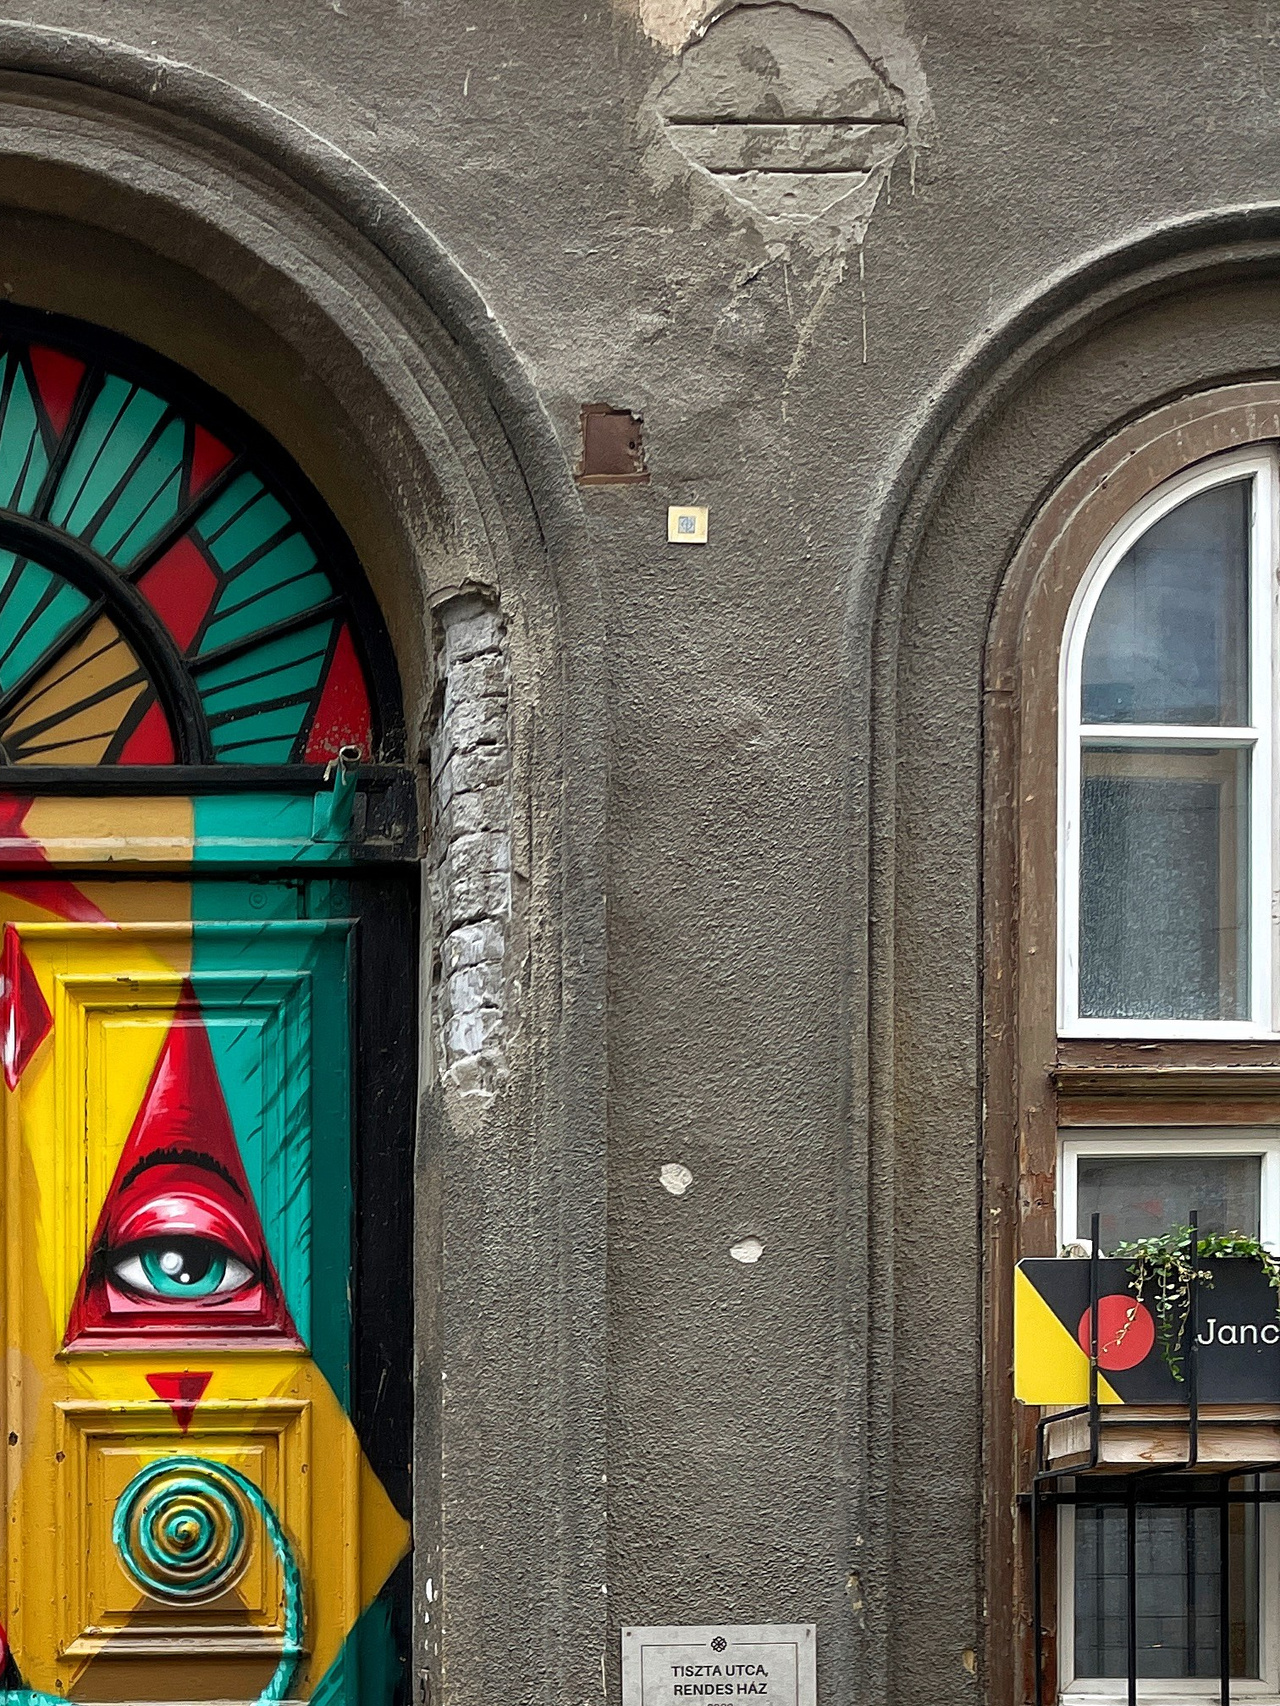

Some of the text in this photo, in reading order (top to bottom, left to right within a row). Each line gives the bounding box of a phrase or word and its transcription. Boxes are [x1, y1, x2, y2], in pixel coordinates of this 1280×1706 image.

[1197, 1318, 1280, 1346] Janc
[671, 1664, 769, 1677] TISZTA UTCA,
[674, 1681, 768, 1696] RENDES HÁZ
